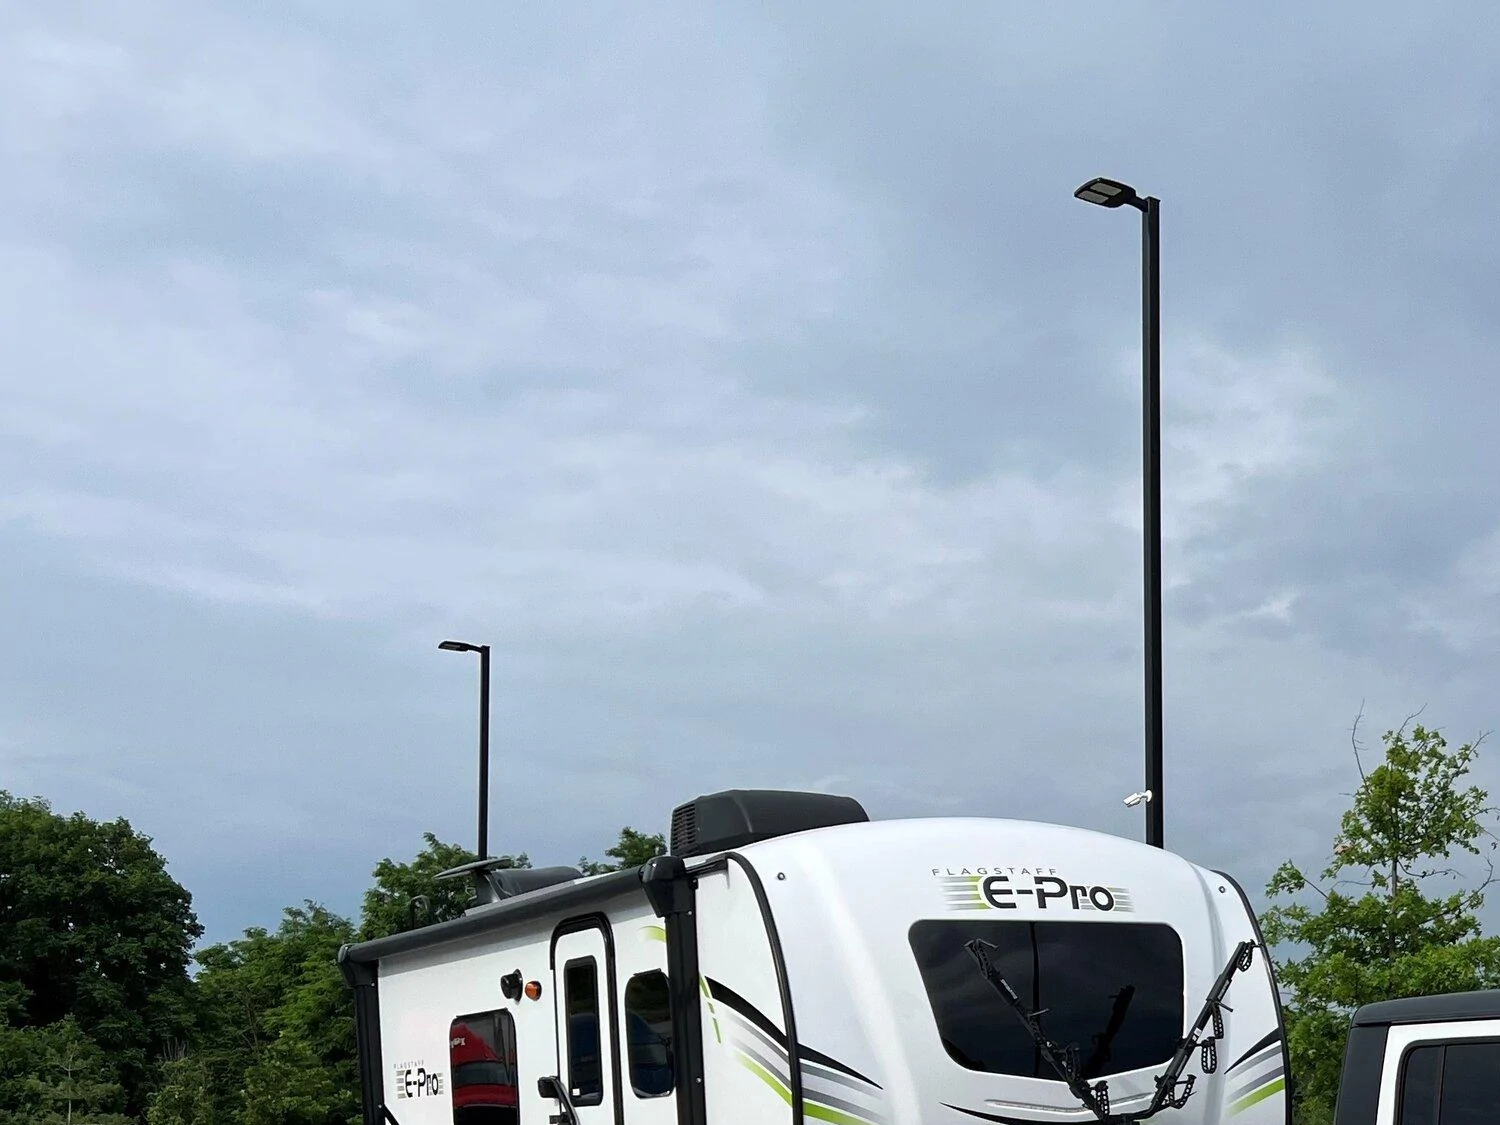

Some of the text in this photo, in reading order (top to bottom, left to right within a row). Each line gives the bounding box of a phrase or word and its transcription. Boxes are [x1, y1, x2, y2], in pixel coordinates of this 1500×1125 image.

[931, 867, 1058, 876] FLAGSTAFF
[982, 876, 1115, 911] E-Pro
[404, 1067, 439, 1098] E-Pro
